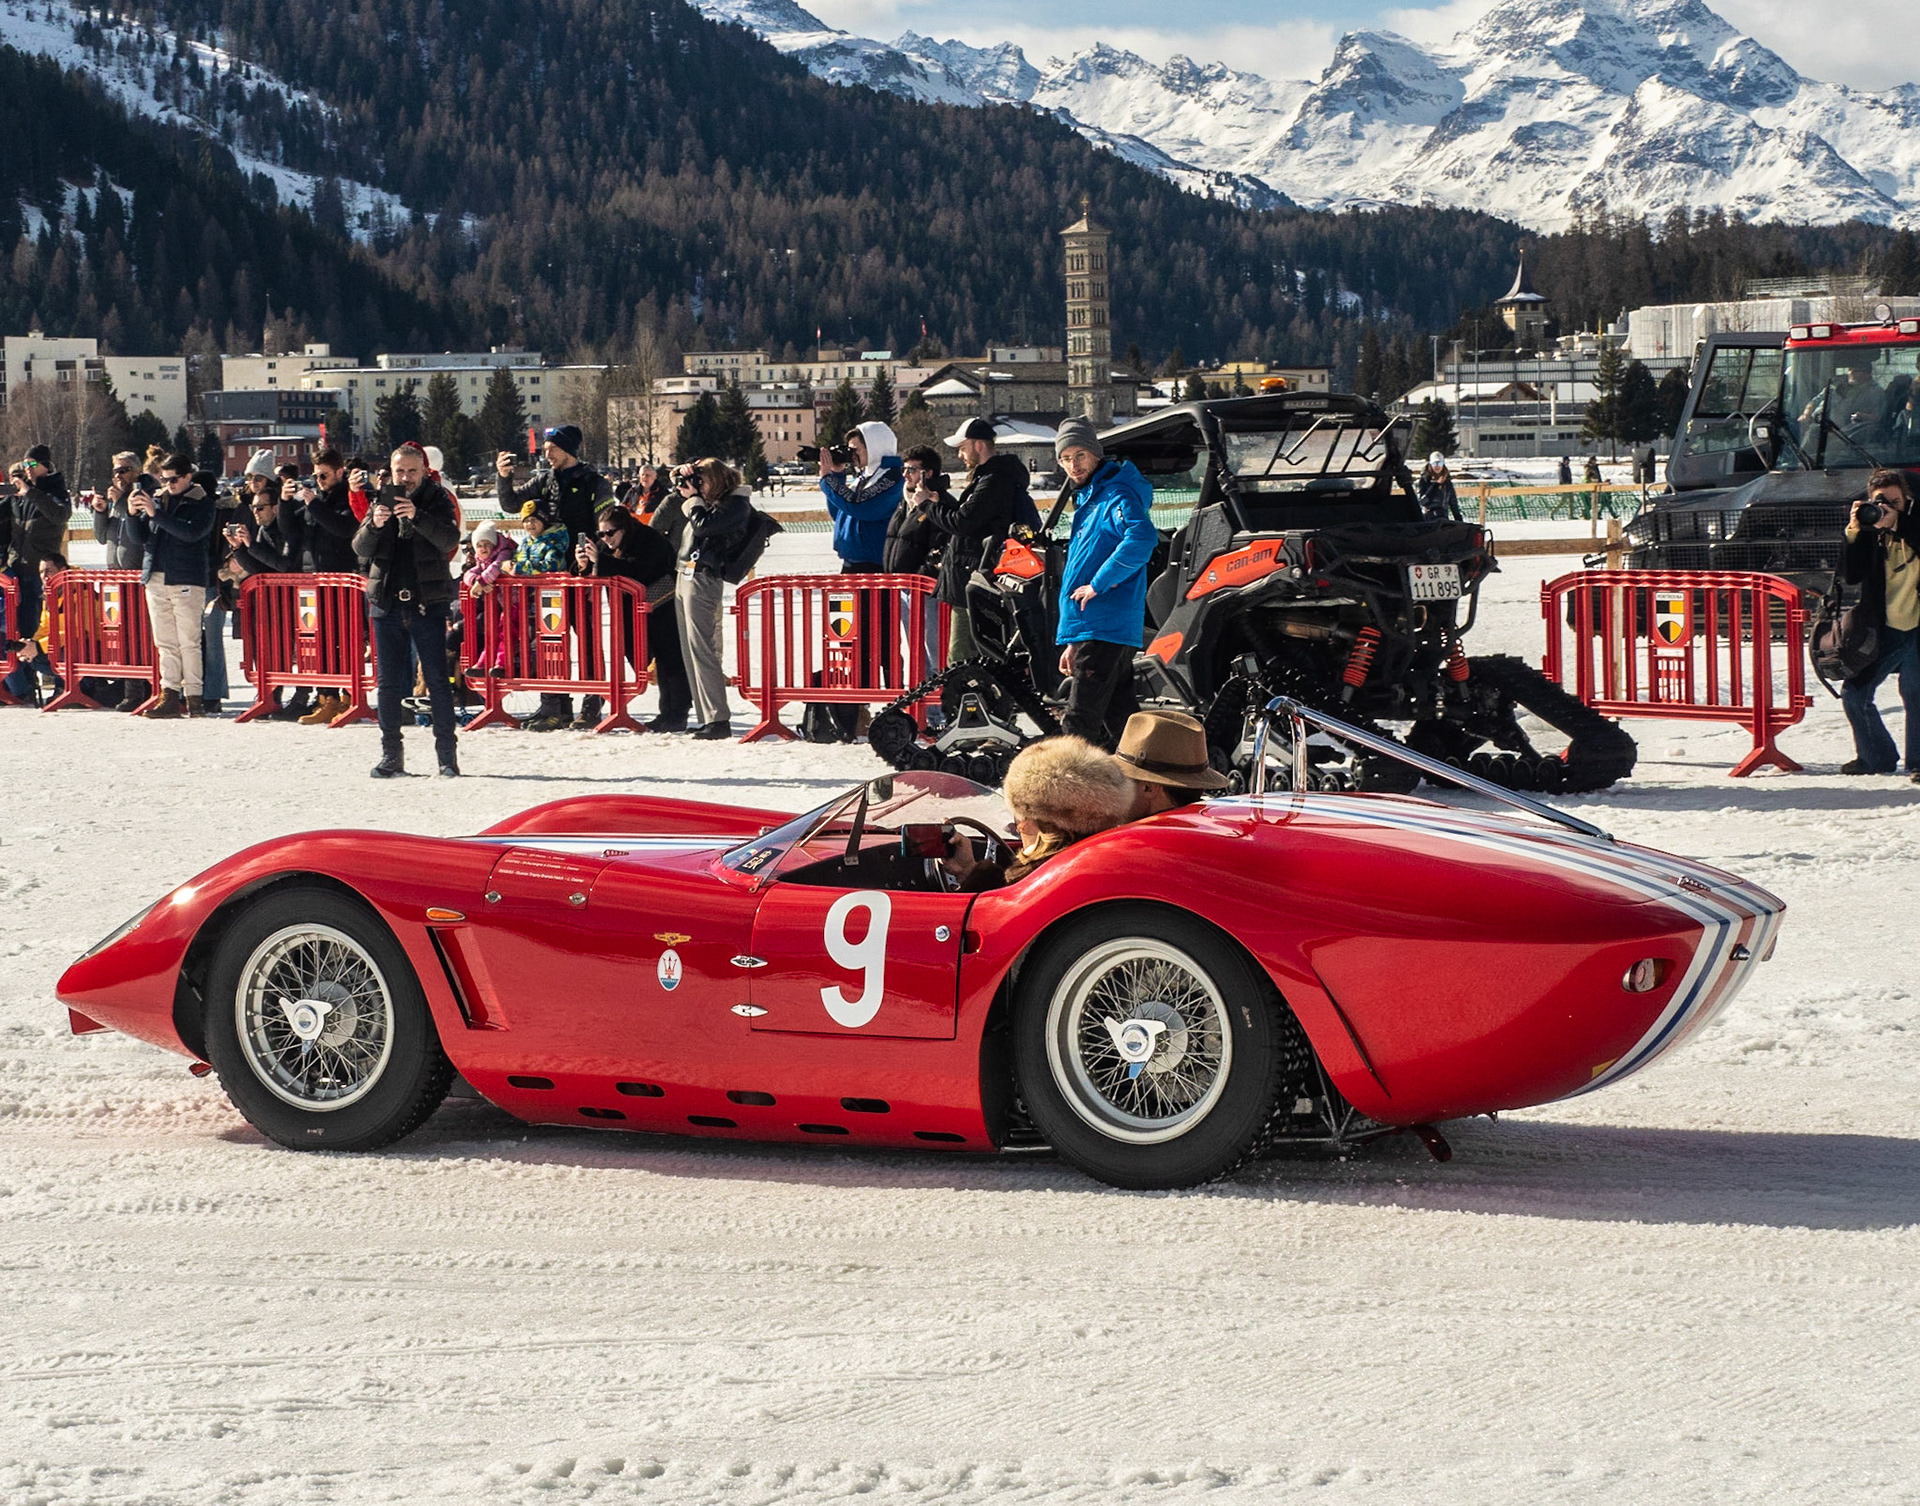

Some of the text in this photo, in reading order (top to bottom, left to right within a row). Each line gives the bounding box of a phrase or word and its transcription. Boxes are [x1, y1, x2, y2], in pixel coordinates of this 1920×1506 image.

[1226, 547, 1273, 573] can-am
[1427, 566, 1440, 579] GR
[820, 890, 892, 1028] 9
